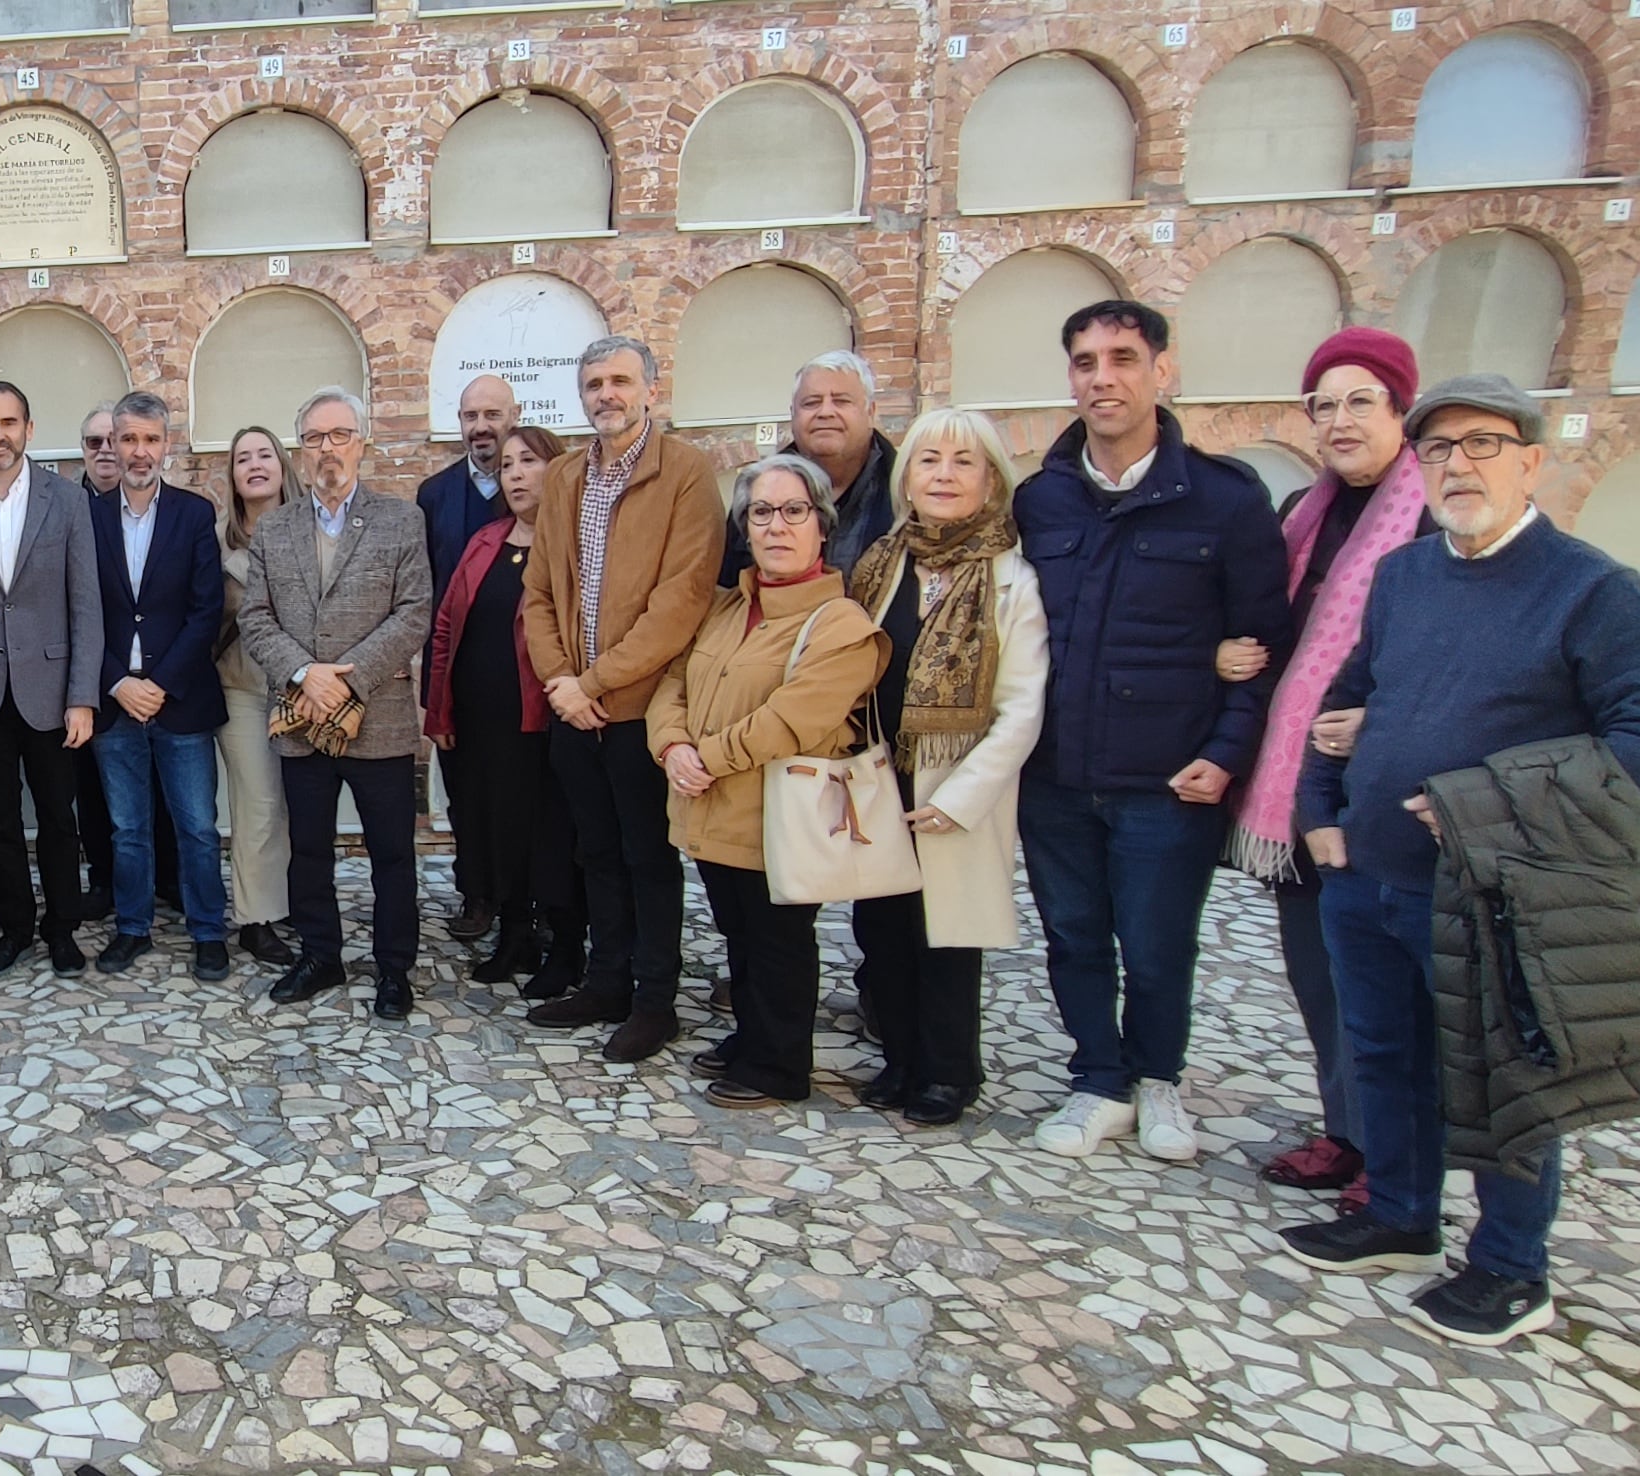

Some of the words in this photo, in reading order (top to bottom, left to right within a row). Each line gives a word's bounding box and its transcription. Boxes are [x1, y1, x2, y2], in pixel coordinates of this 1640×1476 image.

[1396, 13, 1411, 27] 69
[767, 32, 781, 47] 57
[1169, 27, 1184, 42] 65
[512, 43, 527, 58] 53
[948, 41, 962, 55] 61
[265, 59, 280, 74] 49
[20, 71, 35, 86] 45
[8, 131, 71, 155] GENERAL
[765, 232, 779, 247] 58
[1156, 226, 1170, 240] 66
[937, 235, 951, 250] 62
[30, 248, 40, 258] E
[68, 246, 78, 256] P
[517, 246, 531, 261] 54
[272, 259, 286, 274] 50
[31, 271, 44, 286] 46
[459, 359, 486, 371] José
[489, 357, 523, 370] Denis
[501, 372, 540, 384] Pintor
[531, 399, 557, 411] 1844
[539, 413, 565, 425] 1917
[759, 425, 773, 441] 59
